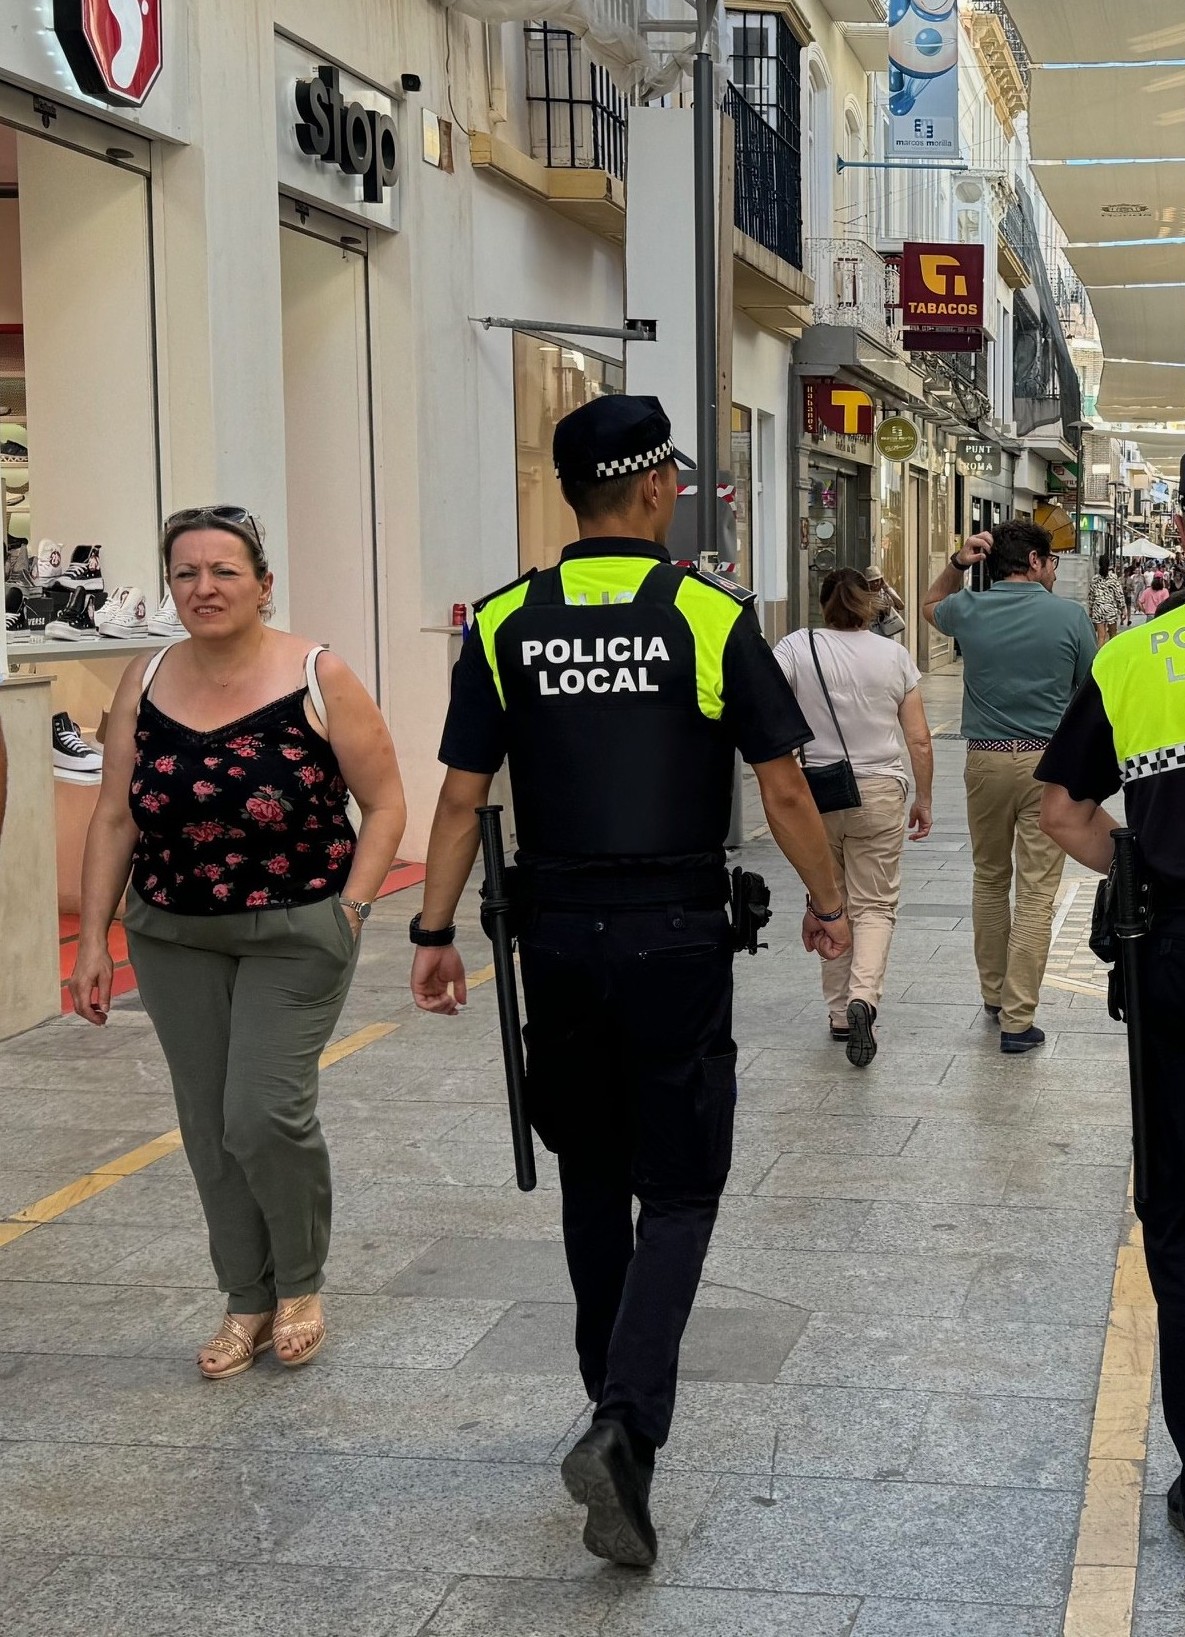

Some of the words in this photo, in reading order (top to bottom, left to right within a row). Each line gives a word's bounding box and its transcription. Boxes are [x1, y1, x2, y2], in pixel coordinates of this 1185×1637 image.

[295, 65, 399, 203] stop
[896, 139, 924, 147] marcos
[926, 139, 952, 147] morilla
[908, 302, 978, 315] TABACOS
[965, 445, 992, 454] PUNT
[522, 636, 670, 666] POLICIA
[538, 667, 659, 696] LOCAL
